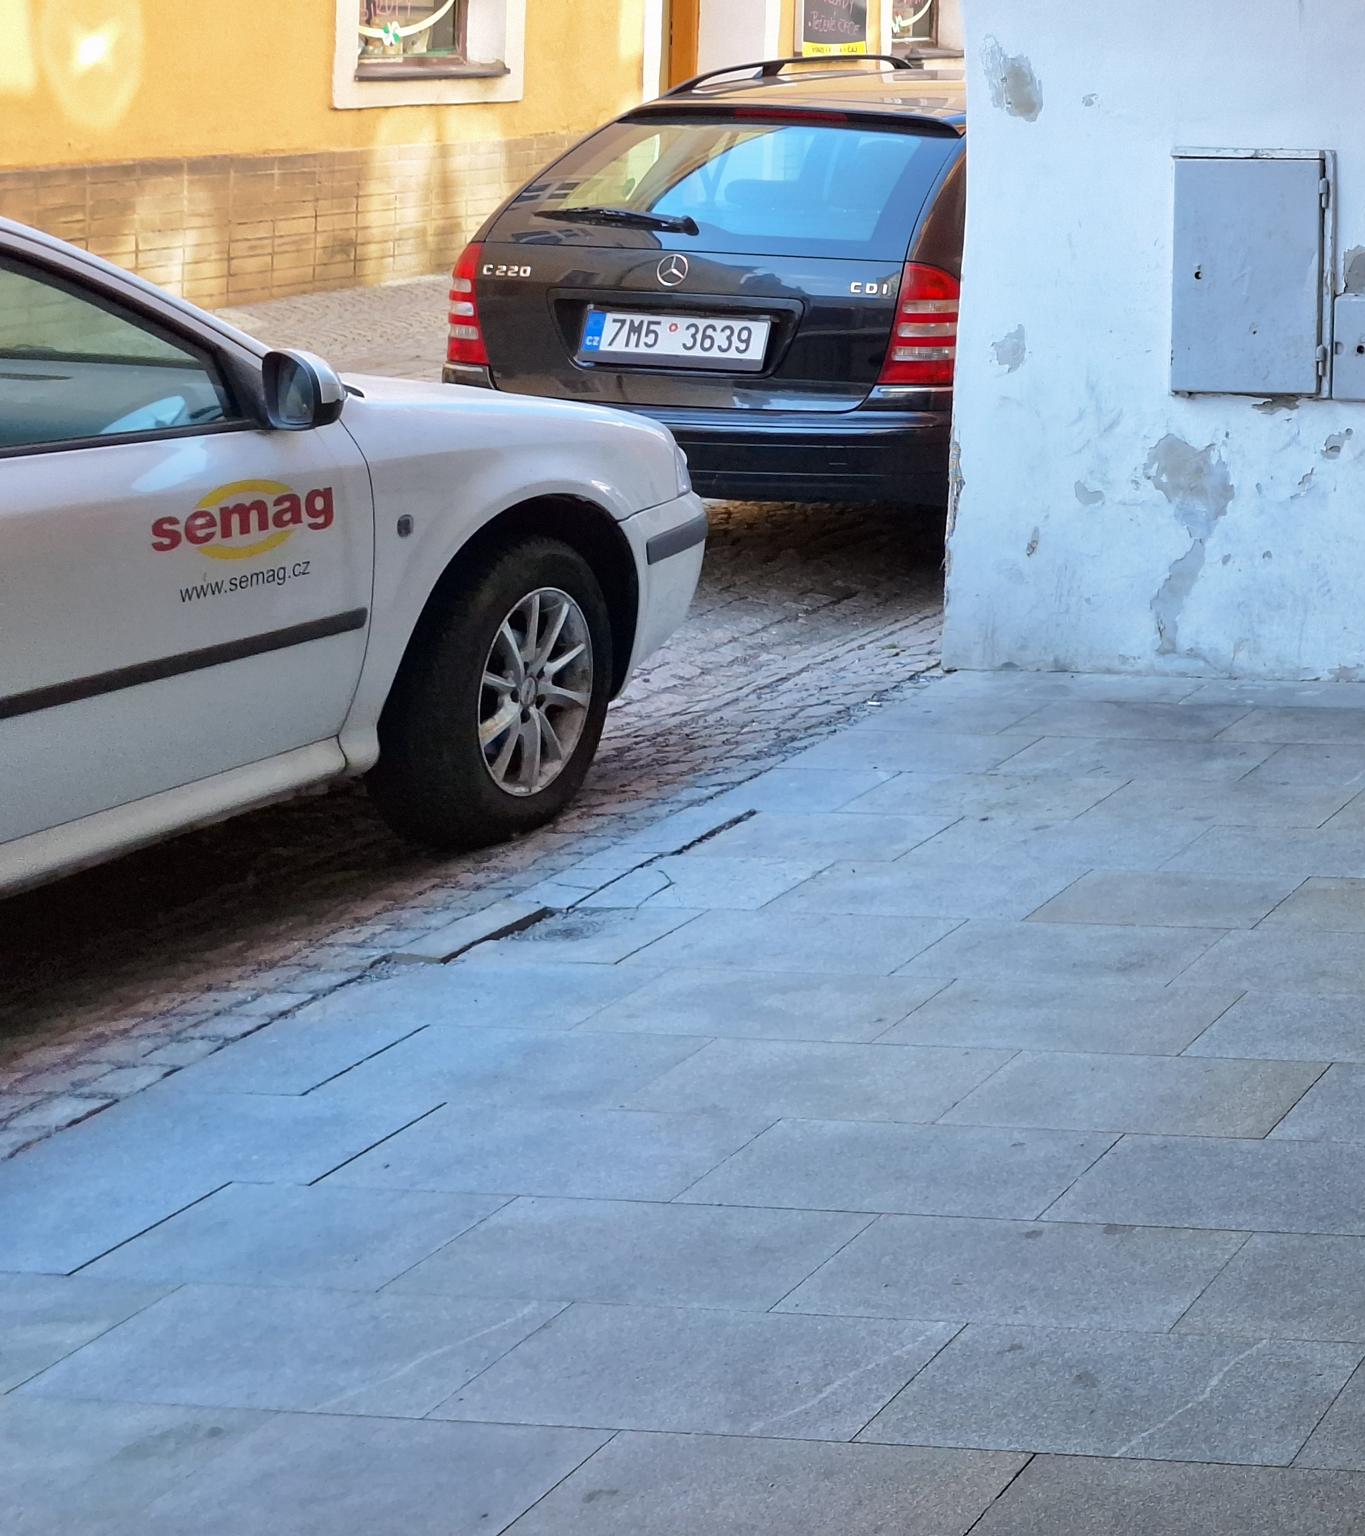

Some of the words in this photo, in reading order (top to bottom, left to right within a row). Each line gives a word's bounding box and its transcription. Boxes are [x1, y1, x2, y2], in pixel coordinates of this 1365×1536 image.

[849, 281, 889, 296] CDI
[607, 319, 661, 348] 7M5
[681, 323, 752, 354] 3639
[151, 486, 335, 552] semag
[179, 560, 311, 603] www.semag.cz
